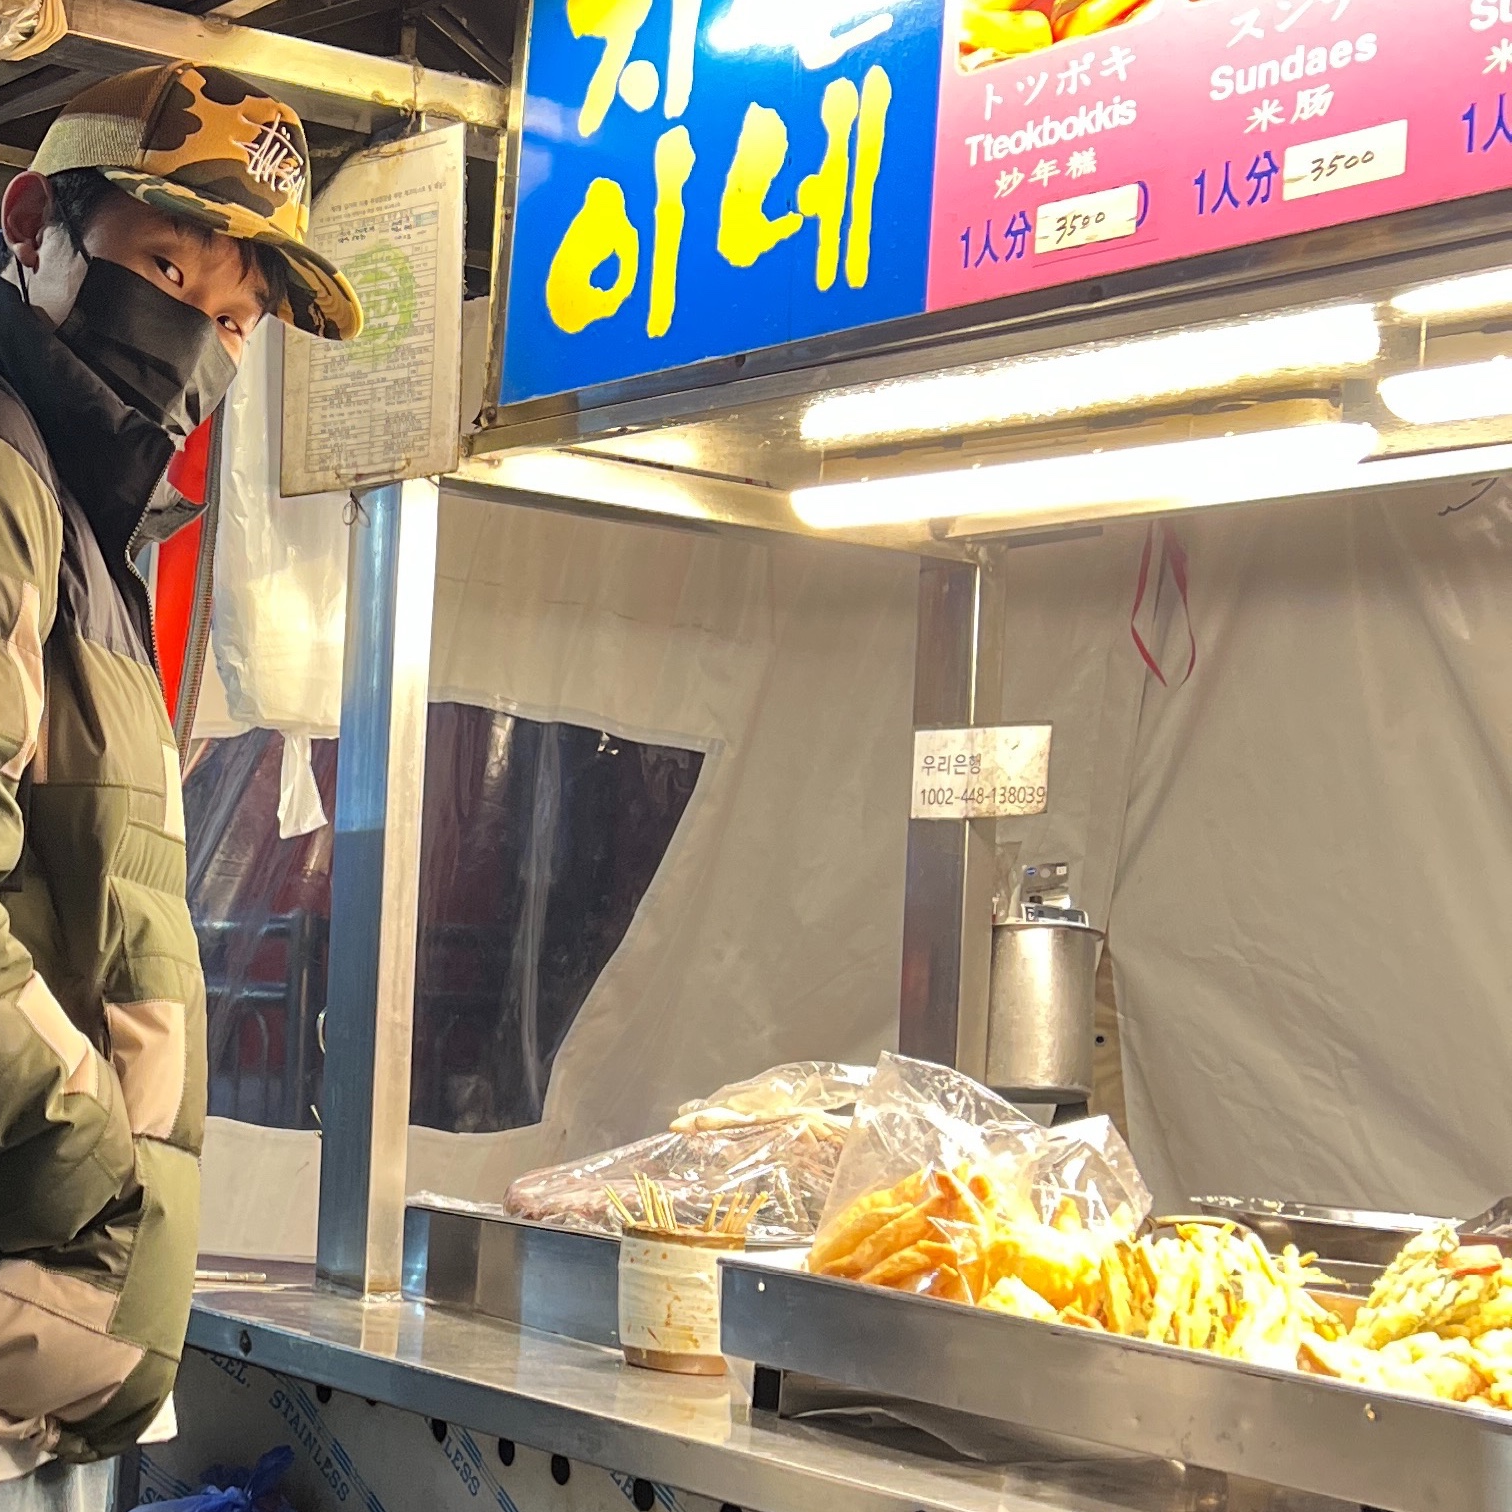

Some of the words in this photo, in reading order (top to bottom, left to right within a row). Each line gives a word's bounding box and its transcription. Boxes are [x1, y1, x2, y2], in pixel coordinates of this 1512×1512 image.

[1209, 32, 1378, 101] Sundaes
[965, 95, 1137, 167] Tteokbokkis
[1193, 150, 1279, 215] 1人分
[1310, 150, 1375, 182] 3500
[960, 210, 1032, 269] 1人分
[1055, 211, 1106, 245] 3500
[921, 753, 982, 776] 우리은행
[921, 786, 1045, 805] 1002-448-138039
[269, 1389, 351, 1501] STAINLESS
